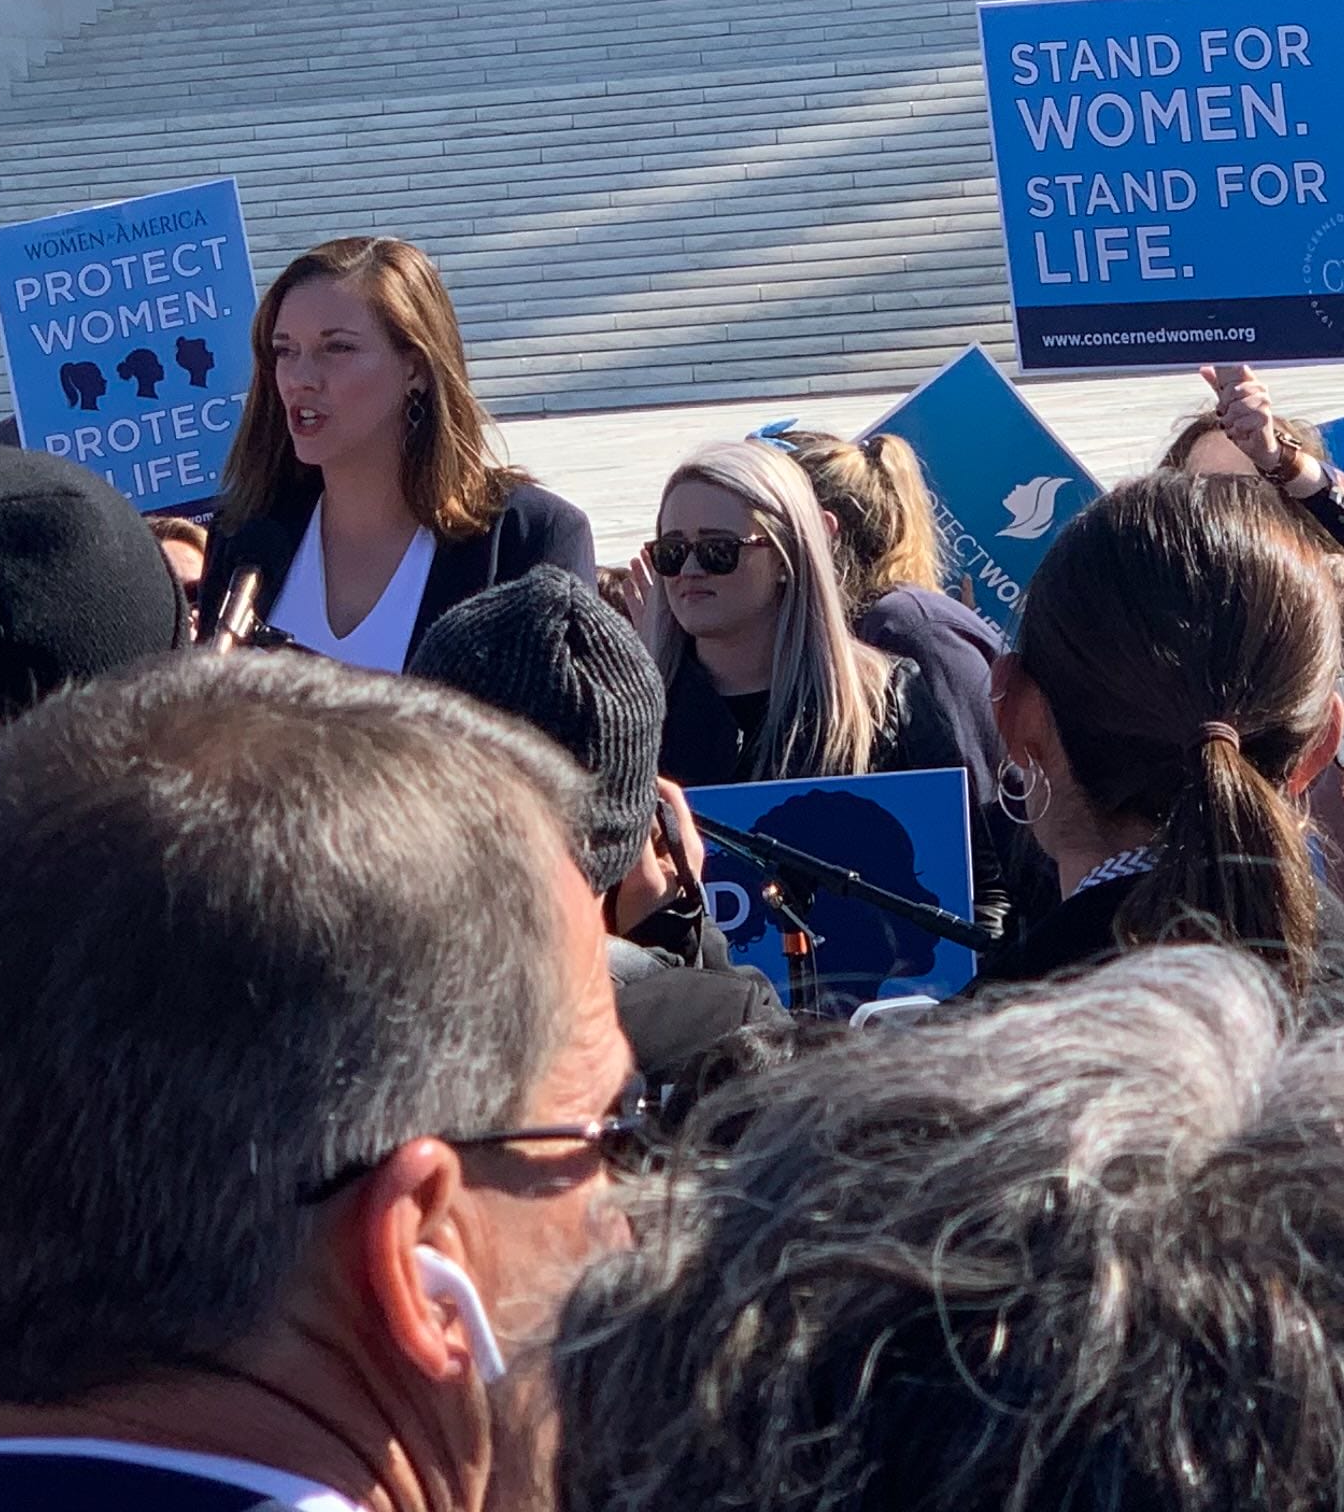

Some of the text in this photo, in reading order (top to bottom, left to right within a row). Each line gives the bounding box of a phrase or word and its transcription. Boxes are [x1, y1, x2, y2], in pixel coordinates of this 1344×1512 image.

[1011, 24, 1312, 86] STAND FOR
[1016, 82, 1309, 151] WOMEN.
[1026, 160, 1328, 219] STAND FOR
[24, 208, 208, 261] WOMEN AMERICA
[1034, 225, 1195, 285] LIFE.
[14, 236, 227, 313] PROTECT
[30, 286, 232, 355] WOMEN.
[1042, 327, 1256, 347] www.concernedwomen.org
